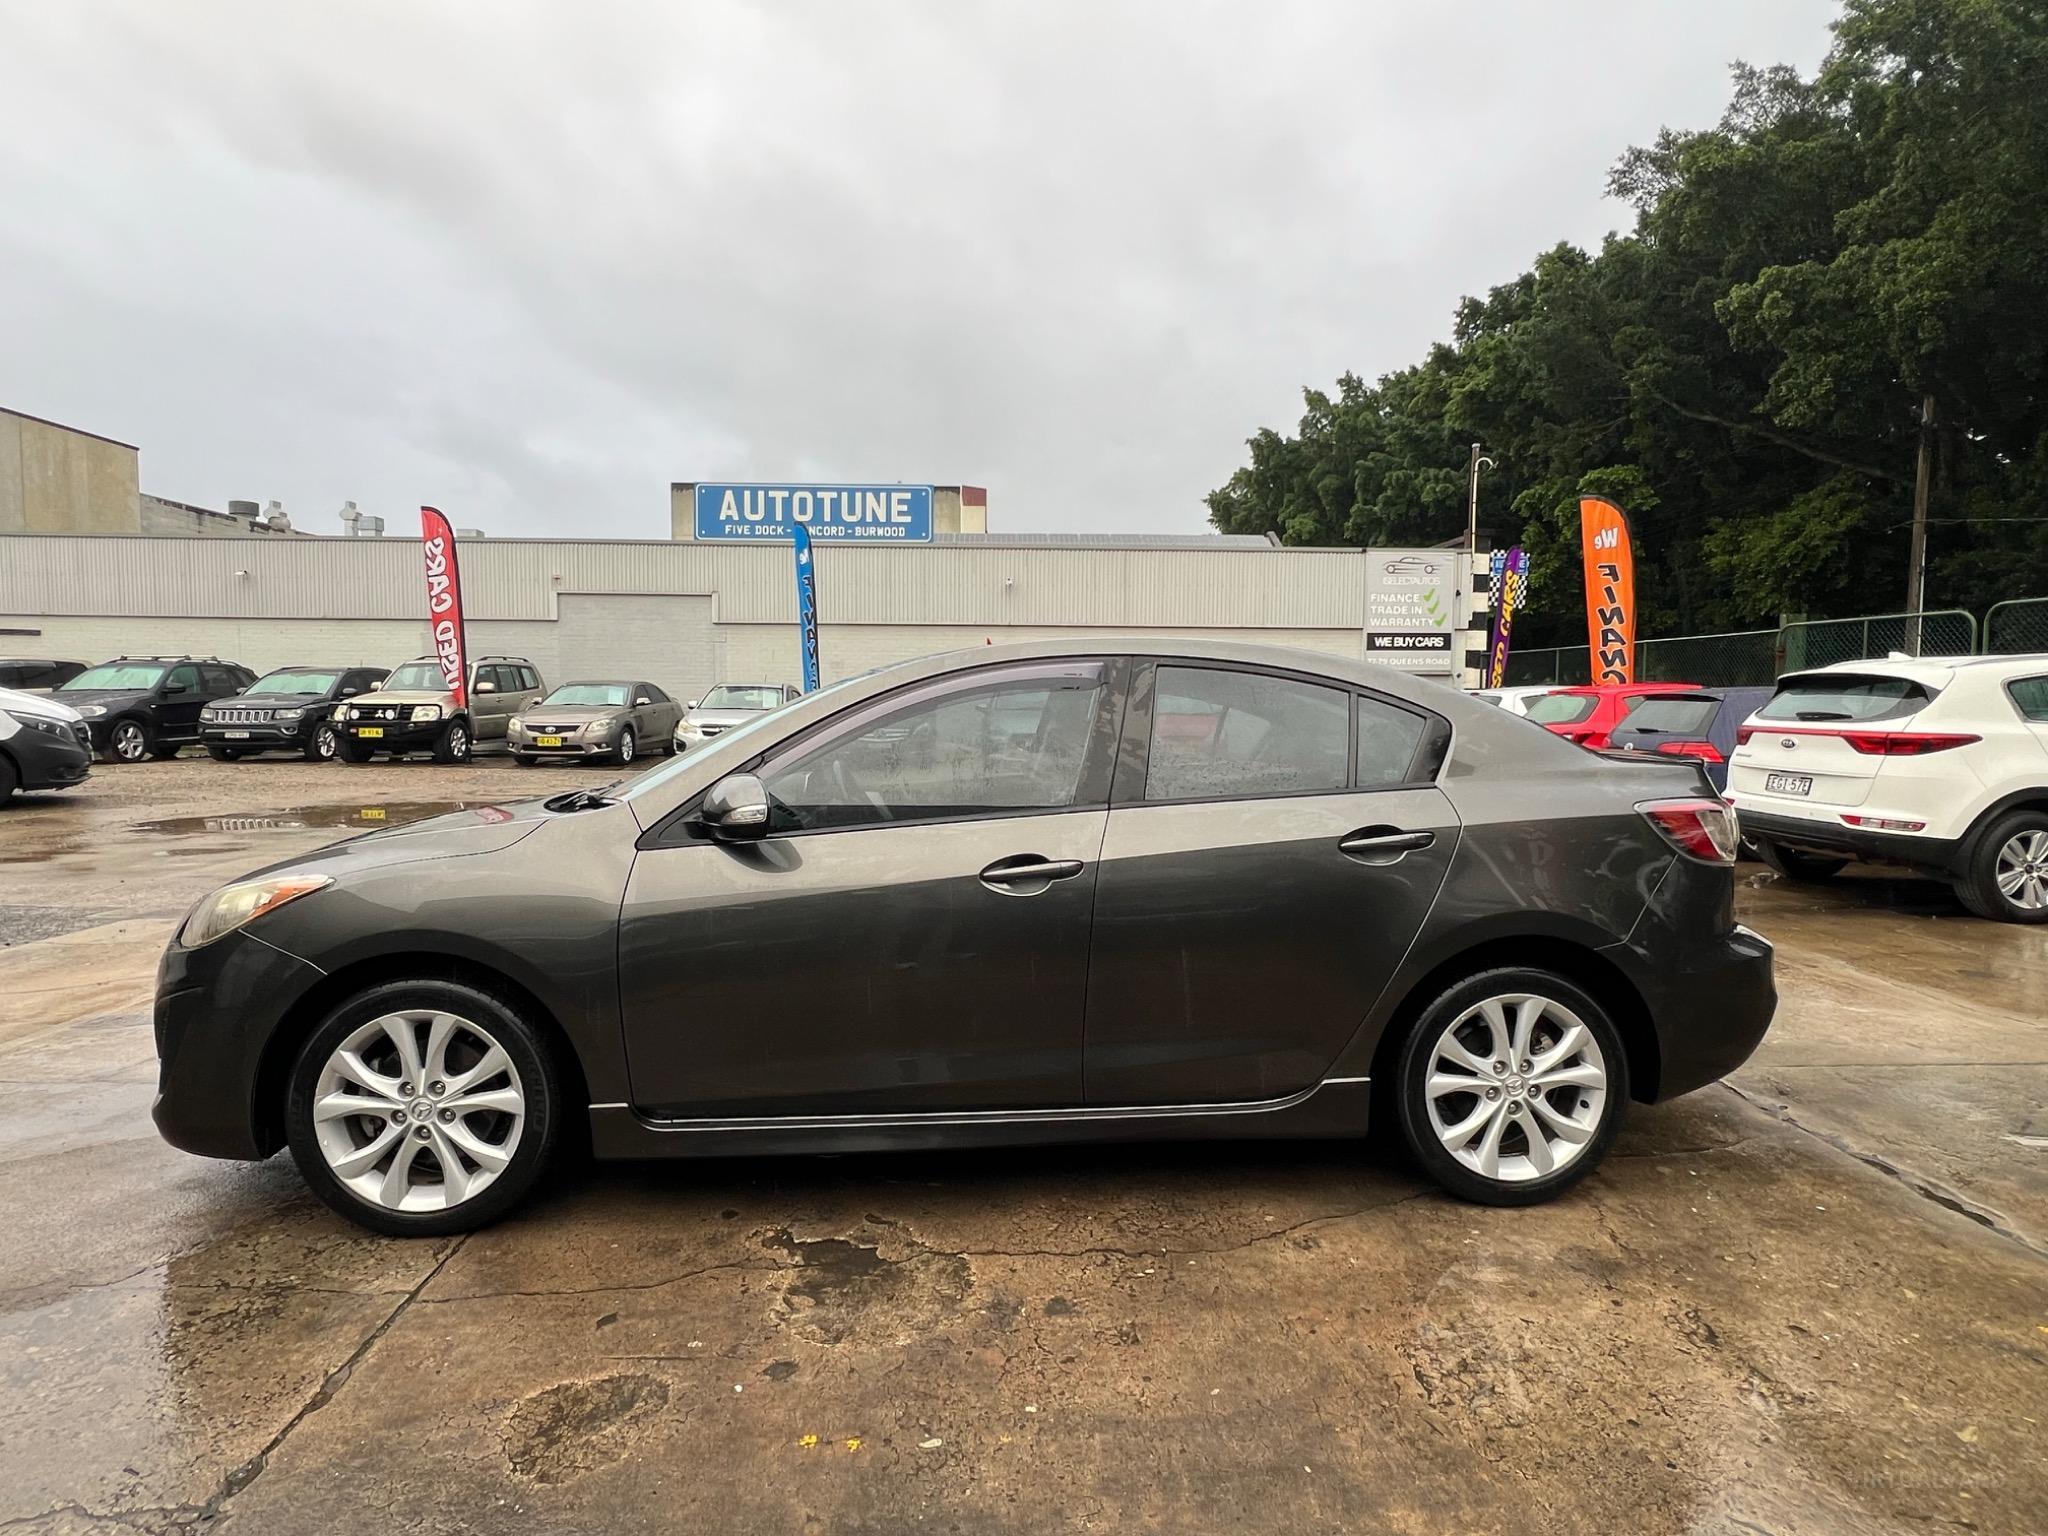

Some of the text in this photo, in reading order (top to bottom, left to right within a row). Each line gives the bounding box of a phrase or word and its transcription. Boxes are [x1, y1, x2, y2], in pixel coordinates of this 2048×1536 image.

[719, 490, 912, 522] AUTOTUNE
[725, 525, 751, 535] FIVE
[755, 525, 784, 535] DOCK
[808, 526, 845, 536] NCORD
[855, 526, 905, 537] BURWOOD
[1370, 593, 1420, 603] FINANCE
[1501, 569, 1519, 637] CARS
[1370, 606, 1422, 615] TRADE IN
[1370, 618, 1434, 627] WARRANTY
[1374, 636, 1444, 647] WE BUY CARS
[1389, 657, 1424, 665] QUEENS
[1425, 657, 1450, 665] ROAD
